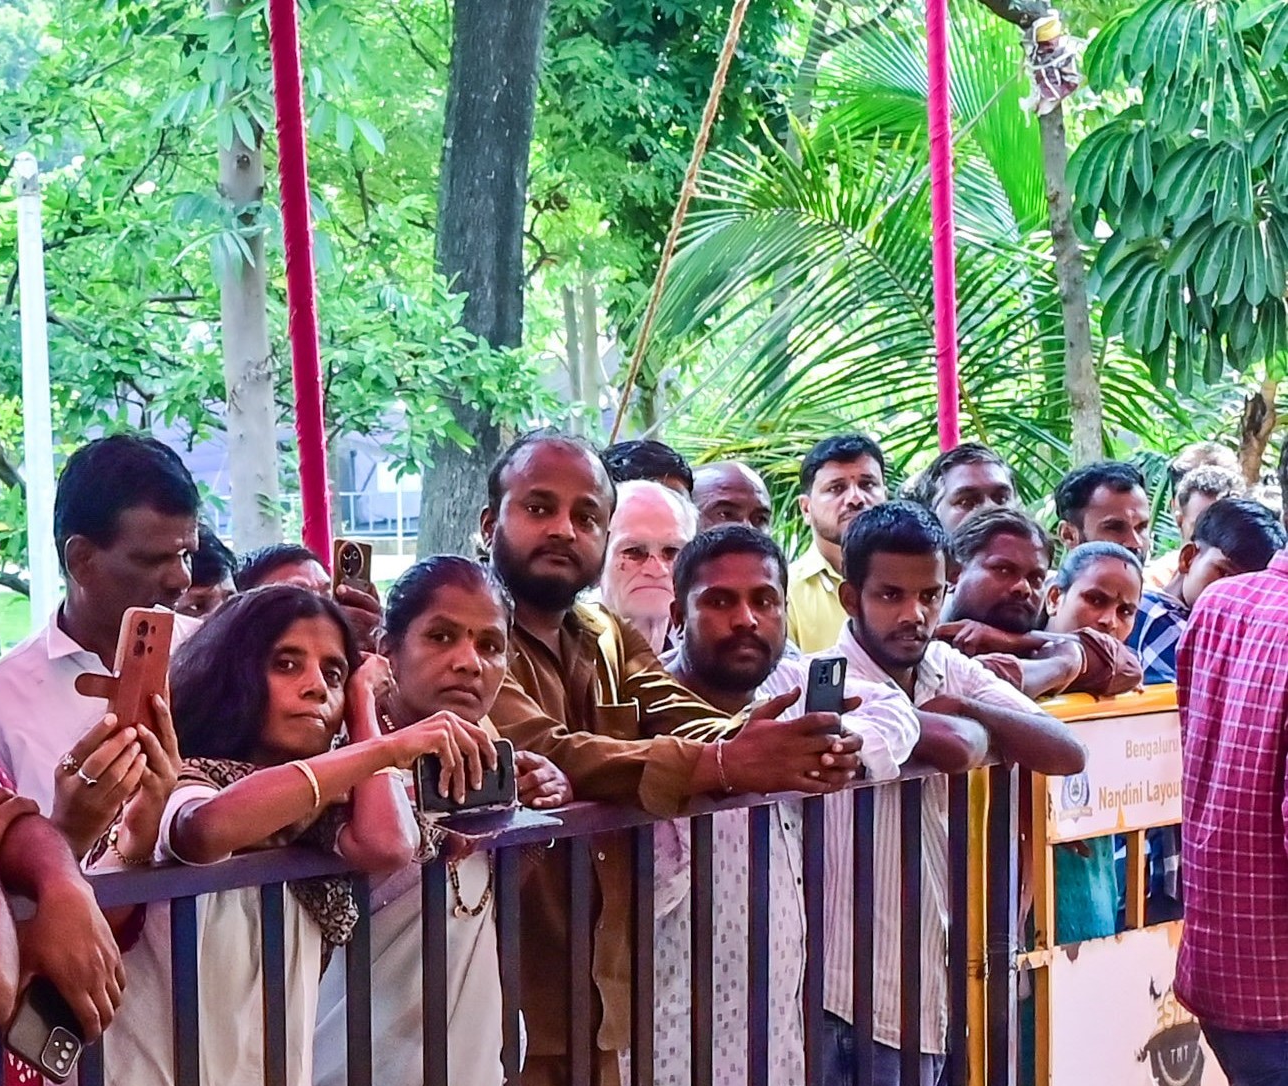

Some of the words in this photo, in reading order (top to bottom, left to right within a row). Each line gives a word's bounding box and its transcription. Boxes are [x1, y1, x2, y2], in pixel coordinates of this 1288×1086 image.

[1125, 736, 1179, 760] Bengaluru
[1098, 781, 1143, 810] Nandini
[1146, 779, 1180, 806] Layou
